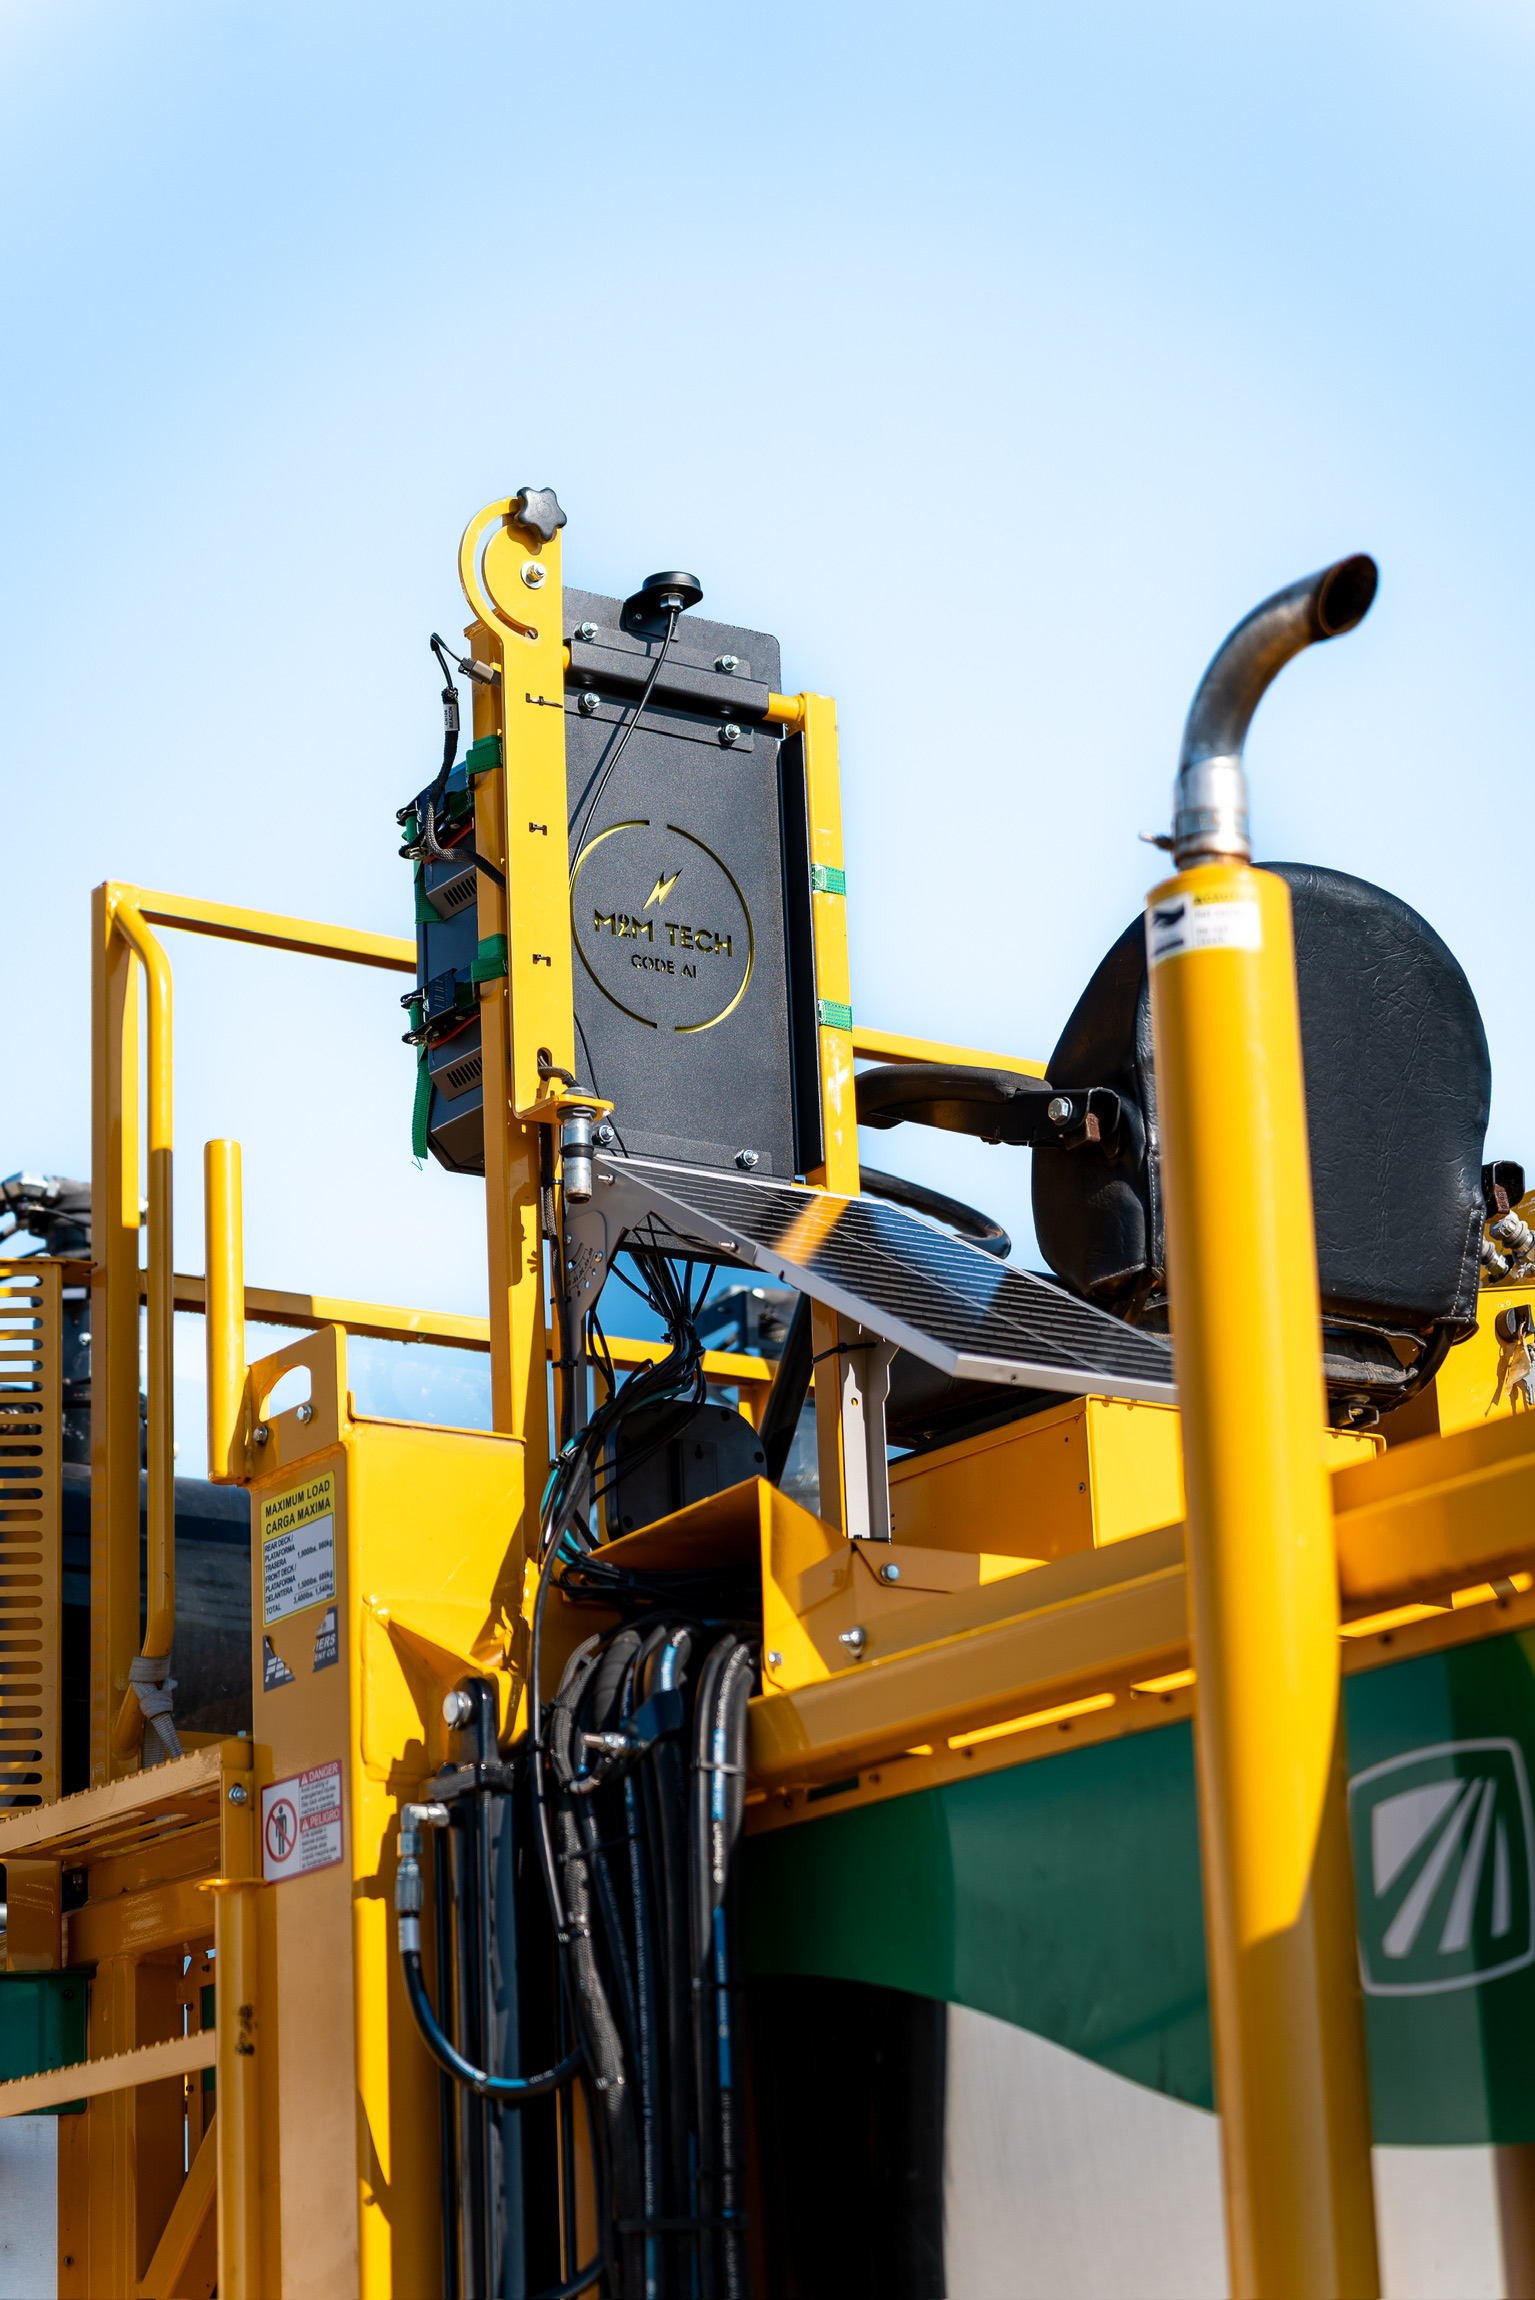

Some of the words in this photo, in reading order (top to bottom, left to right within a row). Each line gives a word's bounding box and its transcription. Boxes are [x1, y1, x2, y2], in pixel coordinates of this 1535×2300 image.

[594, 909, 654, 942] M2M
[665, 922, 733, 957] TECH
[631, 954, 675, 975] CODE
[681, 964, 697, 979] AI
[265, 1490, 304, 1518] MAXIMUM
[307, 1480, 330, 1499] LOAD
[266, 1513, 295, 1535] CARGA
[297, 1497, 331, 1521] MAXIMA
[265, 1541, 278, 1553] REAR
[265, 1544, 295, 1563] PLATAFORMA
[265, 1558, 287, 1573] TRASERA
[265, 1571, 280, 1583] FRONT
[266, 1574, 296, 1593] PLATAFORMA
[266, 1586, 293, 1603] DELANTERA
[266, 1603, 282, 1615] TOTAL
[309, 1762, 338, 1782] DANGER
[309, 1807, 340, 1828] PELIGRO
